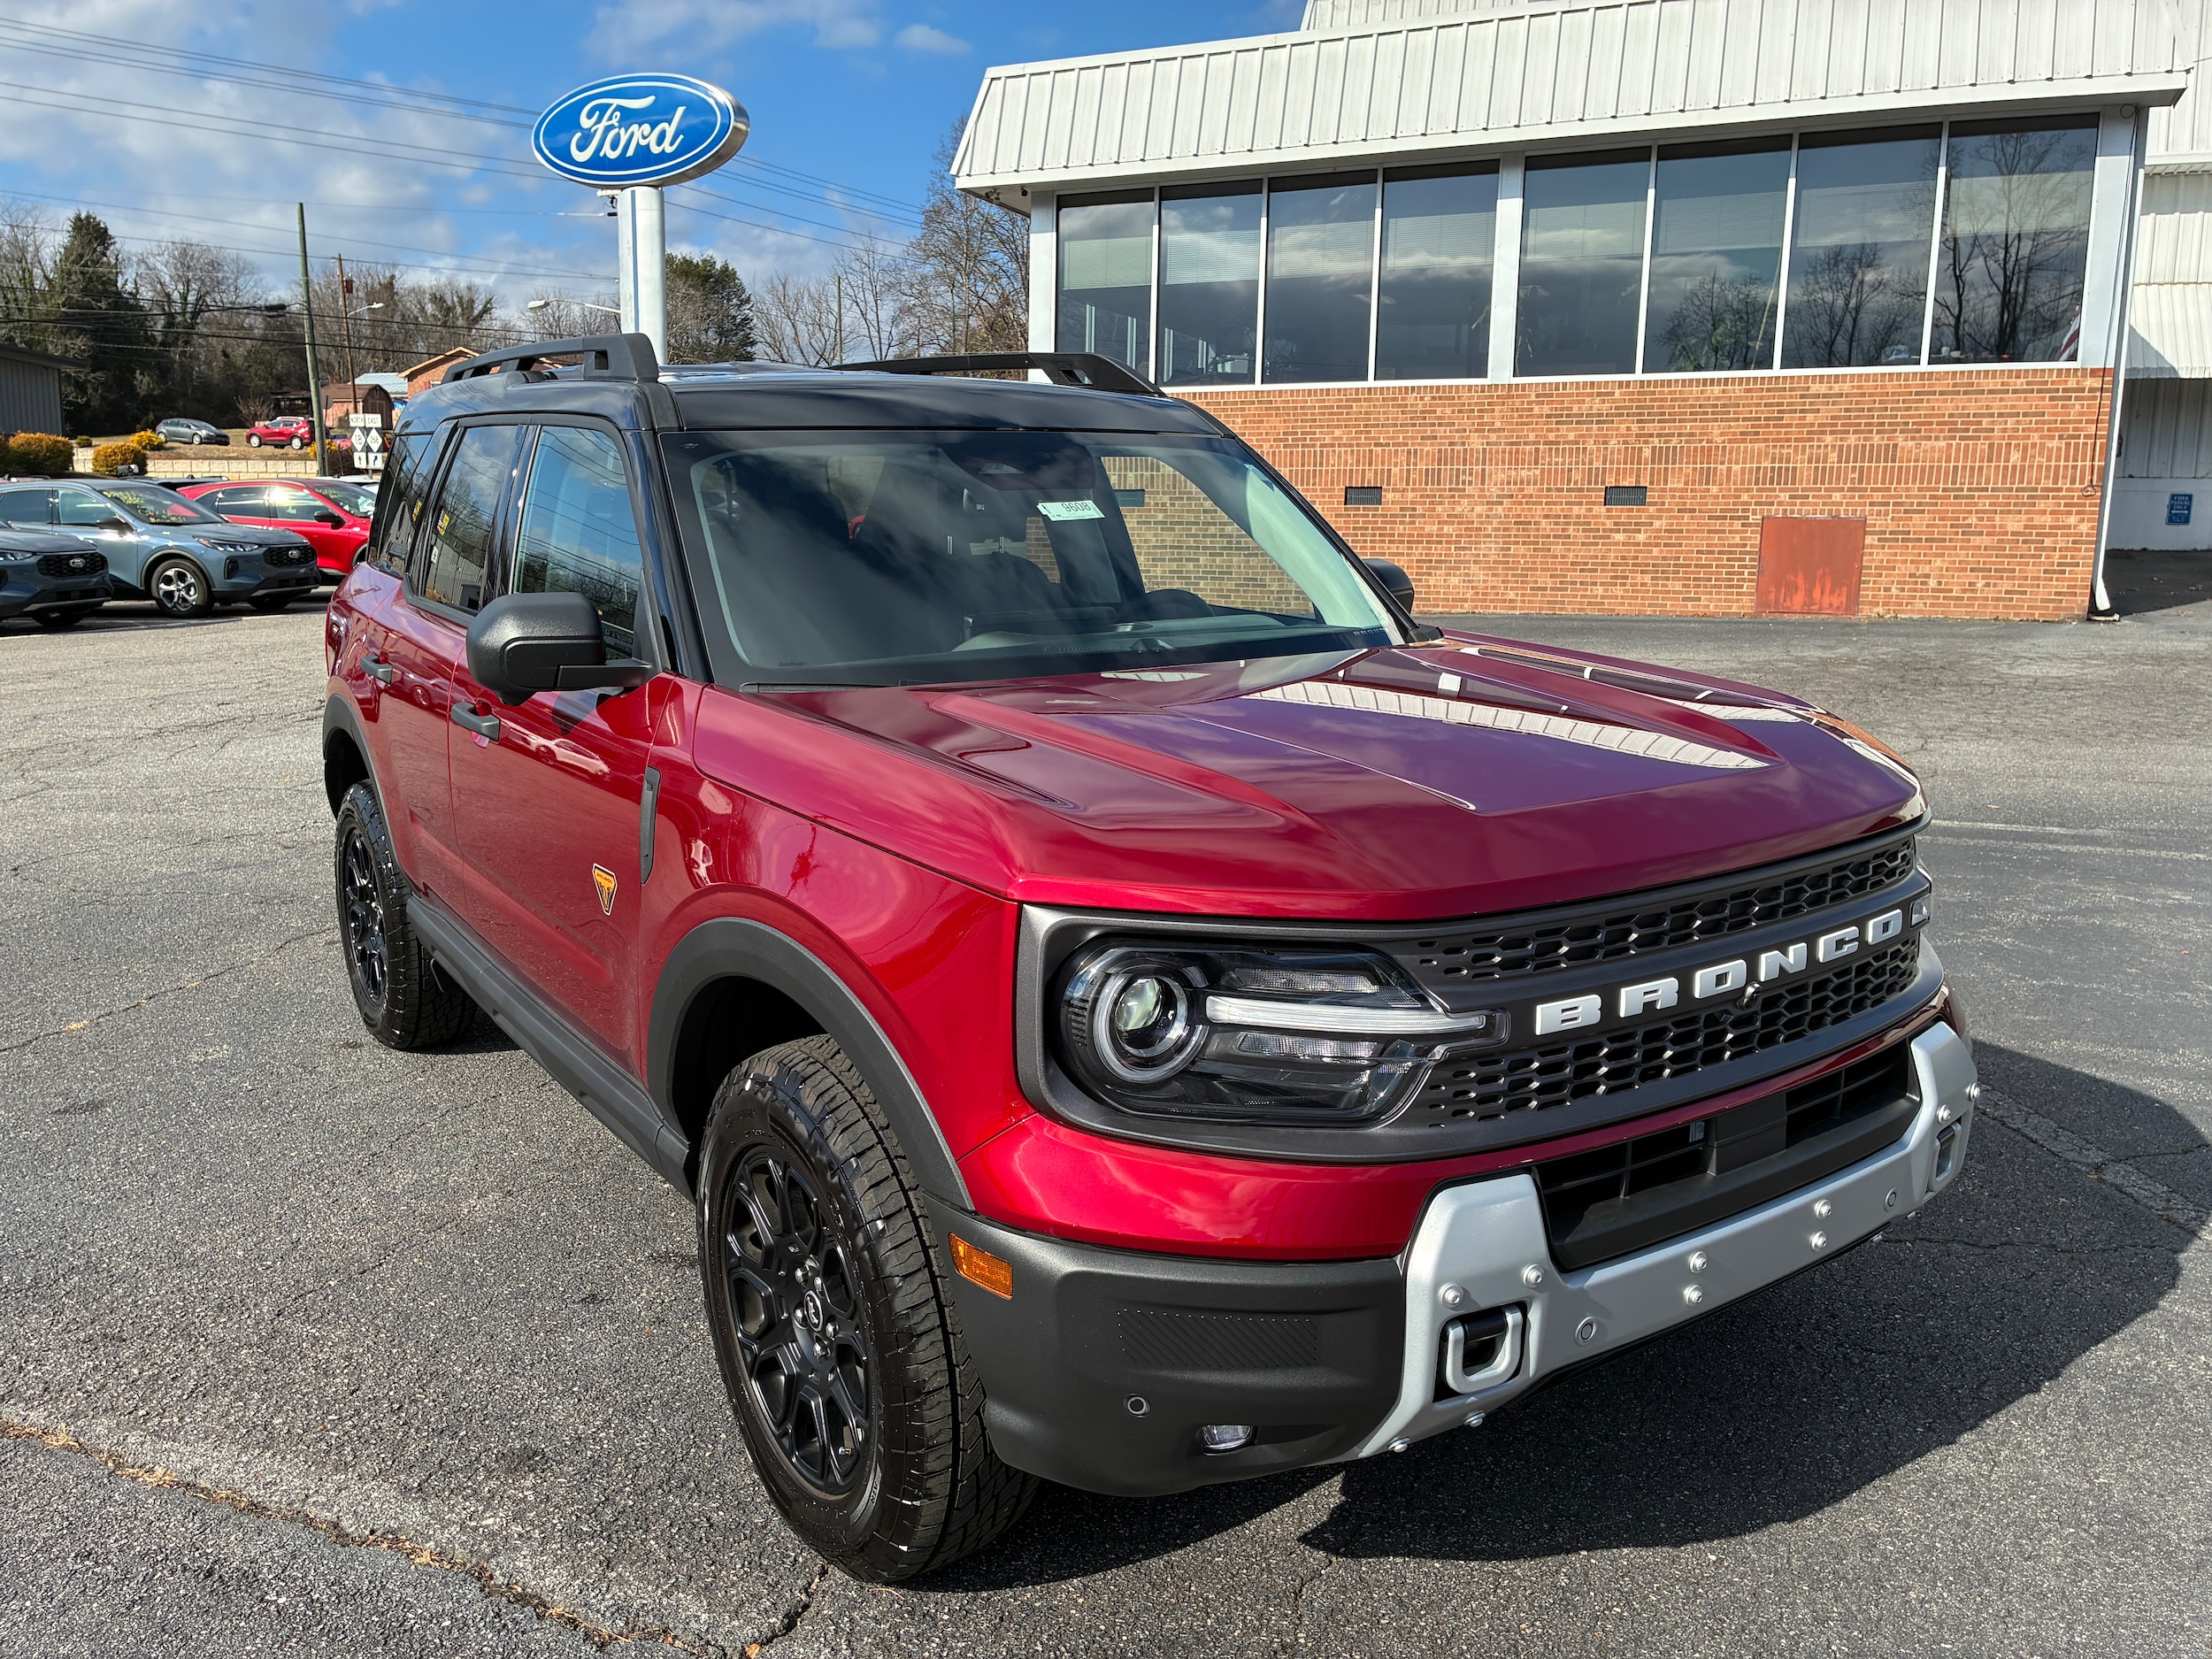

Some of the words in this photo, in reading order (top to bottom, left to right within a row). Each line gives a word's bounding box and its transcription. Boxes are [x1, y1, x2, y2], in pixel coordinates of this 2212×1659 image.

[570, 95, 687, 163] Ford
[354, 434, 363, 445] 18
[370, 435, 380, 444] 268
[1061, 502, 1092, 512] 9608
[1535, 909, 1903, 1036] BRONCO
